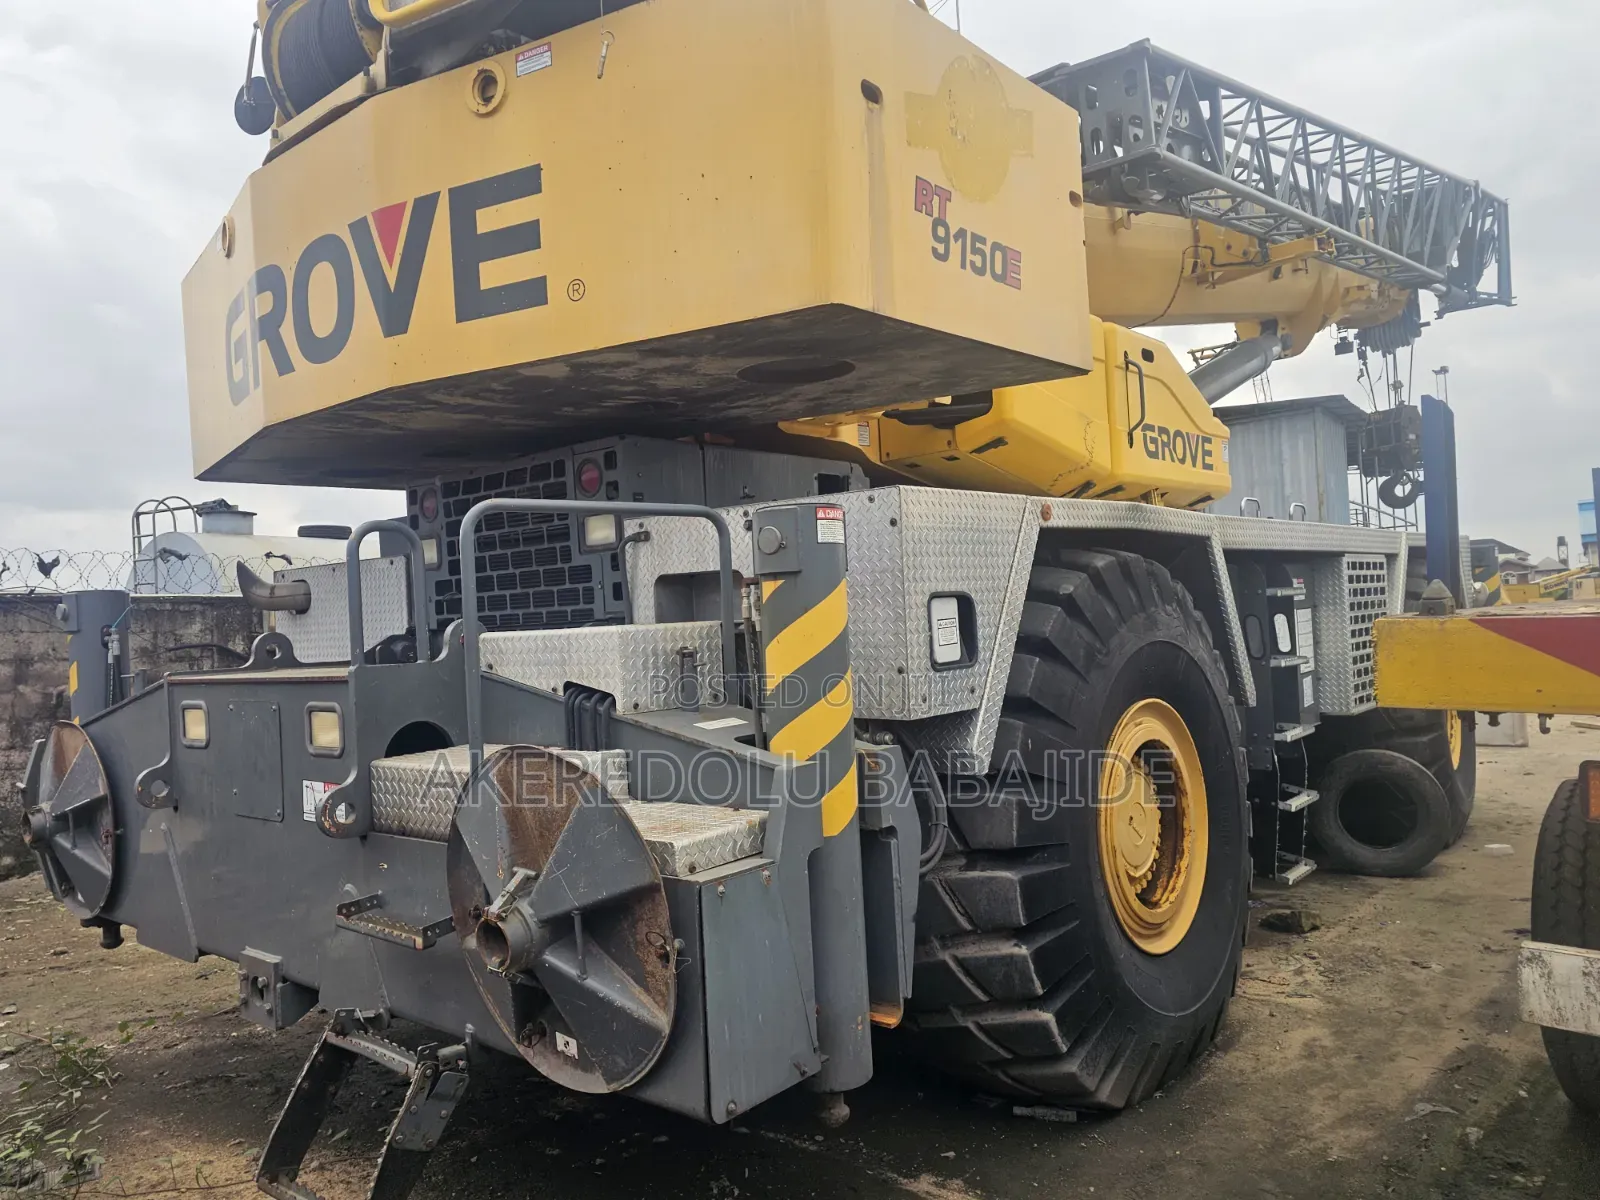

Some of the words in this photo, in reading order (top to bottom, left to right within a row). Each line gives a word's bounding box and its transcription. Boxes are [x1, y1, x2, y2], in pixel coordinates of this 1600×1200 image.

[524, 45, 549, 59] DANGER
[914, 175, 952, 221] RT
[931, 216, 1022, 290] 9150E
[225, 163, 549, 407] GROVE
[1141, 422, 1214, 471] GROVE
